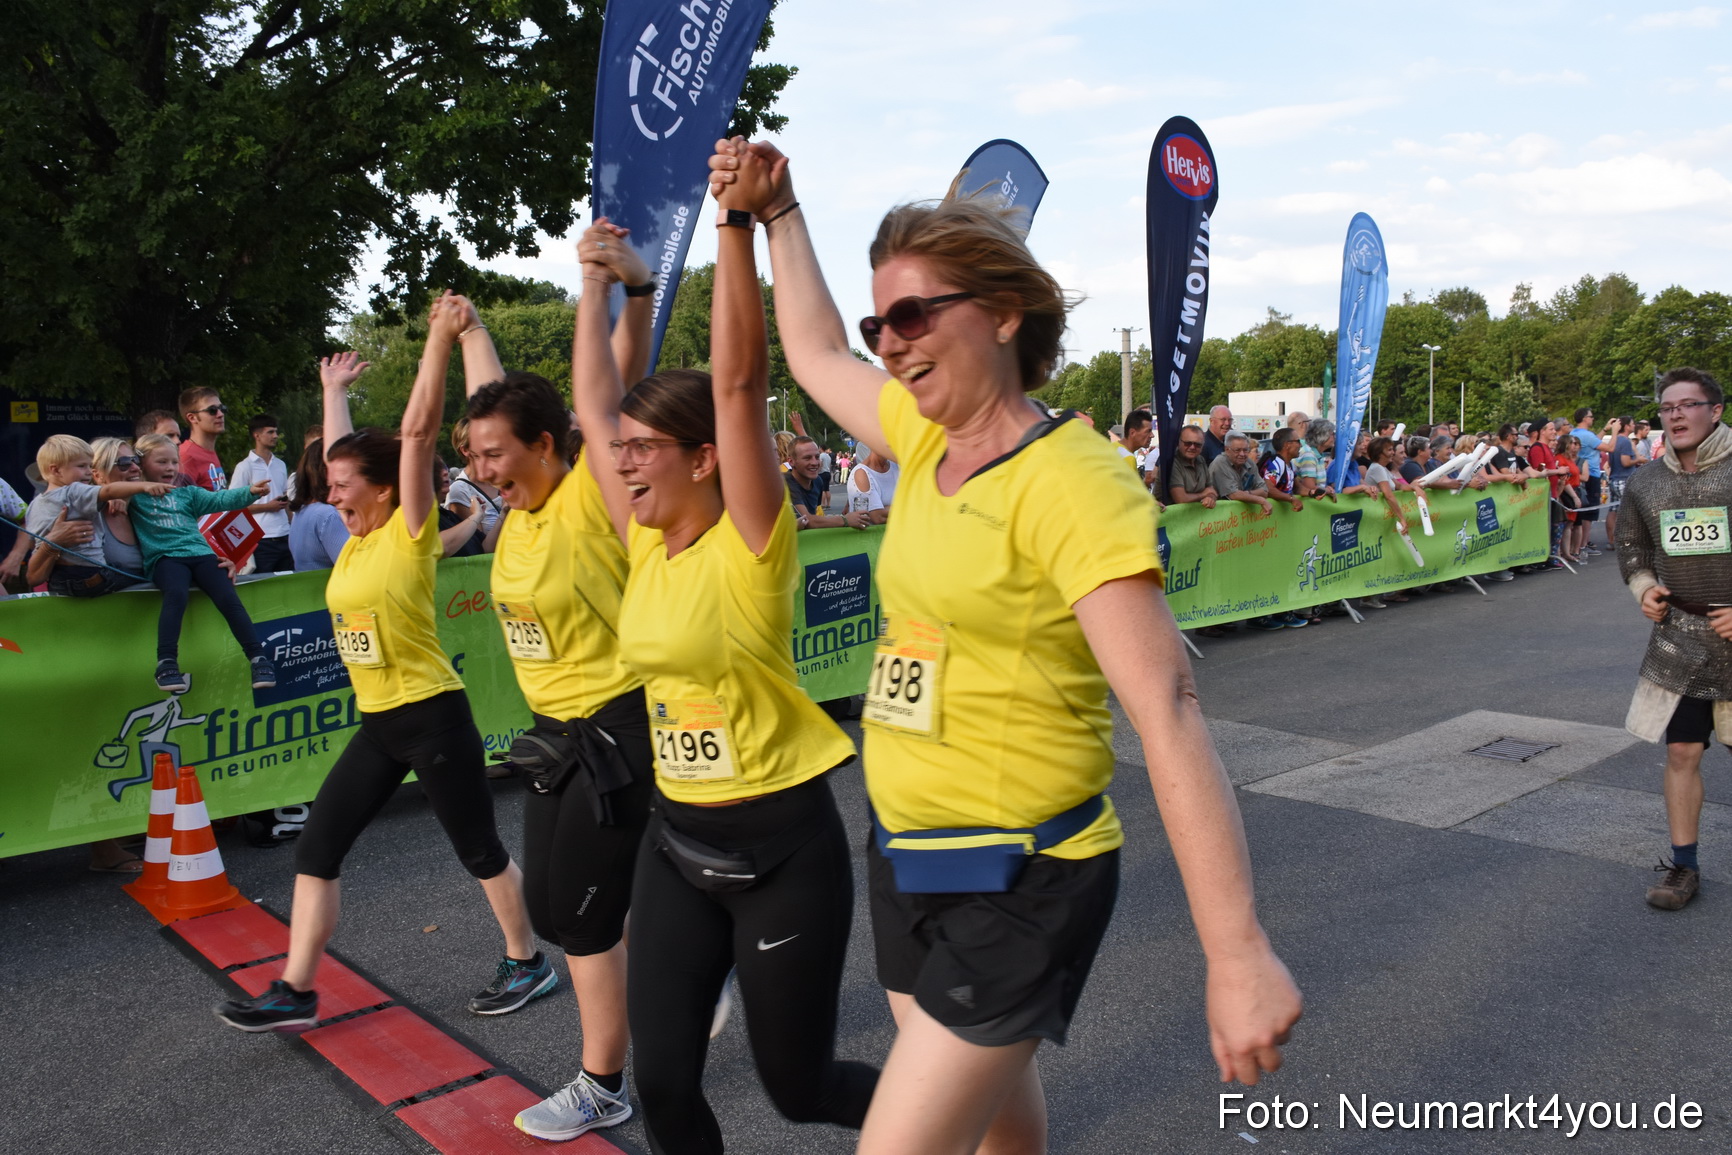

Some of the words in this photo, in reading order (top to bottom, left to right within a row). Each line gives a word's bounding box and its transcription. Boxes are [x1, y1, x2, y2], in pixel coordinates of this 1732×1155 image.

[652, 0, 712, 112] Fisch
[1166, 145, 1211, 187] Hervis
[46, 413, 65, 421] Zum
[67, 413, 90, 421] Glück
[92, 413, 102, 421] ist
[75, 404, 94, 412] noch
[1669, 524, 1719, 542] 2033
[1319, 535, 1383, 579] firmenlauf
[817, 576, 862, 594] Fischer
[821, 586, 858, 599] AUTOMOBILE
[506, 621, 543, 646] 2185
[281, 651, 341, 668] AUTOMOBIL
[656, 730, 721, 763] 2196
[211, 736, 330, 782] neumarkt
[576, 893, 594, 916] Reebok
